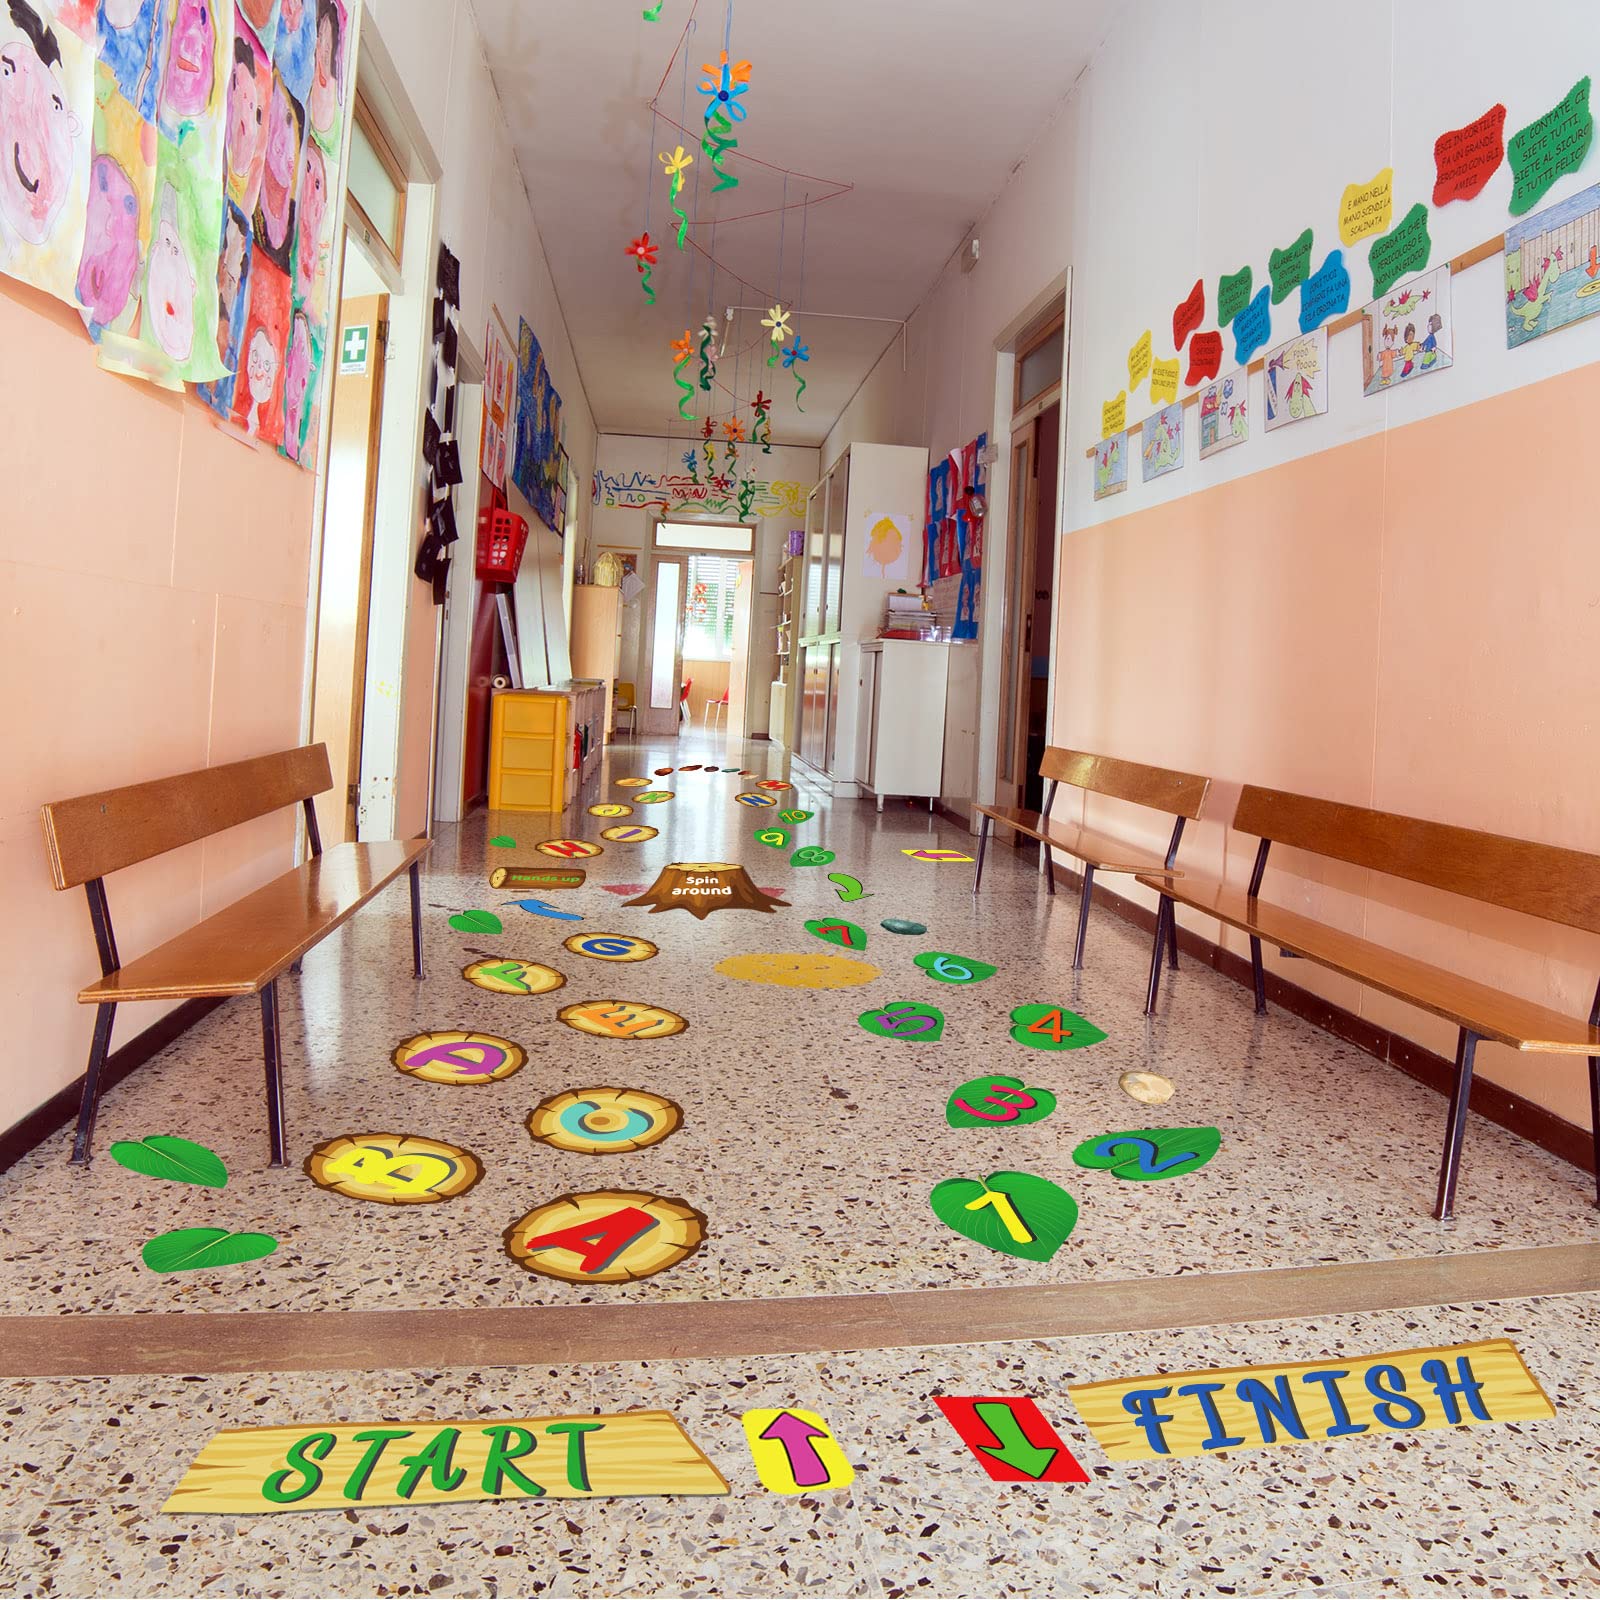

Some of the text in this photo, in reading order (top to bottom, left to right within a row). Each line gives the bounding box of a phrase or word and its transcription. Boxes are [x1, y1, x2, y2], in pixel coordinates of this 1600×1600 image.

[1575, 89, 1586, 105] CI
[1522, 135, 1548, 163] SIETE
[1514, 158, 1542, 185] SIETE
[1543, 151, 1554, 166] AL
[1517, 186, 1524, 200] E
[1526, 167, 1554, 193] TUTTI
[782, 810, 808, 822] 10
[543, 841, 591, 857] H
[760, 832, 784, 846] 9
[797, 849, 829, 863] 8
[511, 874, 559, 883] Hands
[671, 885, 732, 895] around
[686, 876, 719, 885] Spin
[581, 938, 636, 956] G
[817, 925, 853, 945] 7
[479, 962, 533, 992] F
[934, 957, 974, 981] 6
[577, 1005, 665, 1035] E
[875, 1006, 938, 1037] 5
[1027, 1008, 1073, 1043] 4
[403, 1041, 507, 1075] D
[953, 1084, 1038, 1122] 3
[559, 1100, 655, 1141] C
[325, 1145, 457, 1194] B
[1094, 1137, 1200, 1174] 2
[964, 1191, 1038, 1244] 1
[526, 1206, 660, 1274] A
[1121, 1356, 1493, 1454] FINISH
[261, 1422, 606, 1503] START
